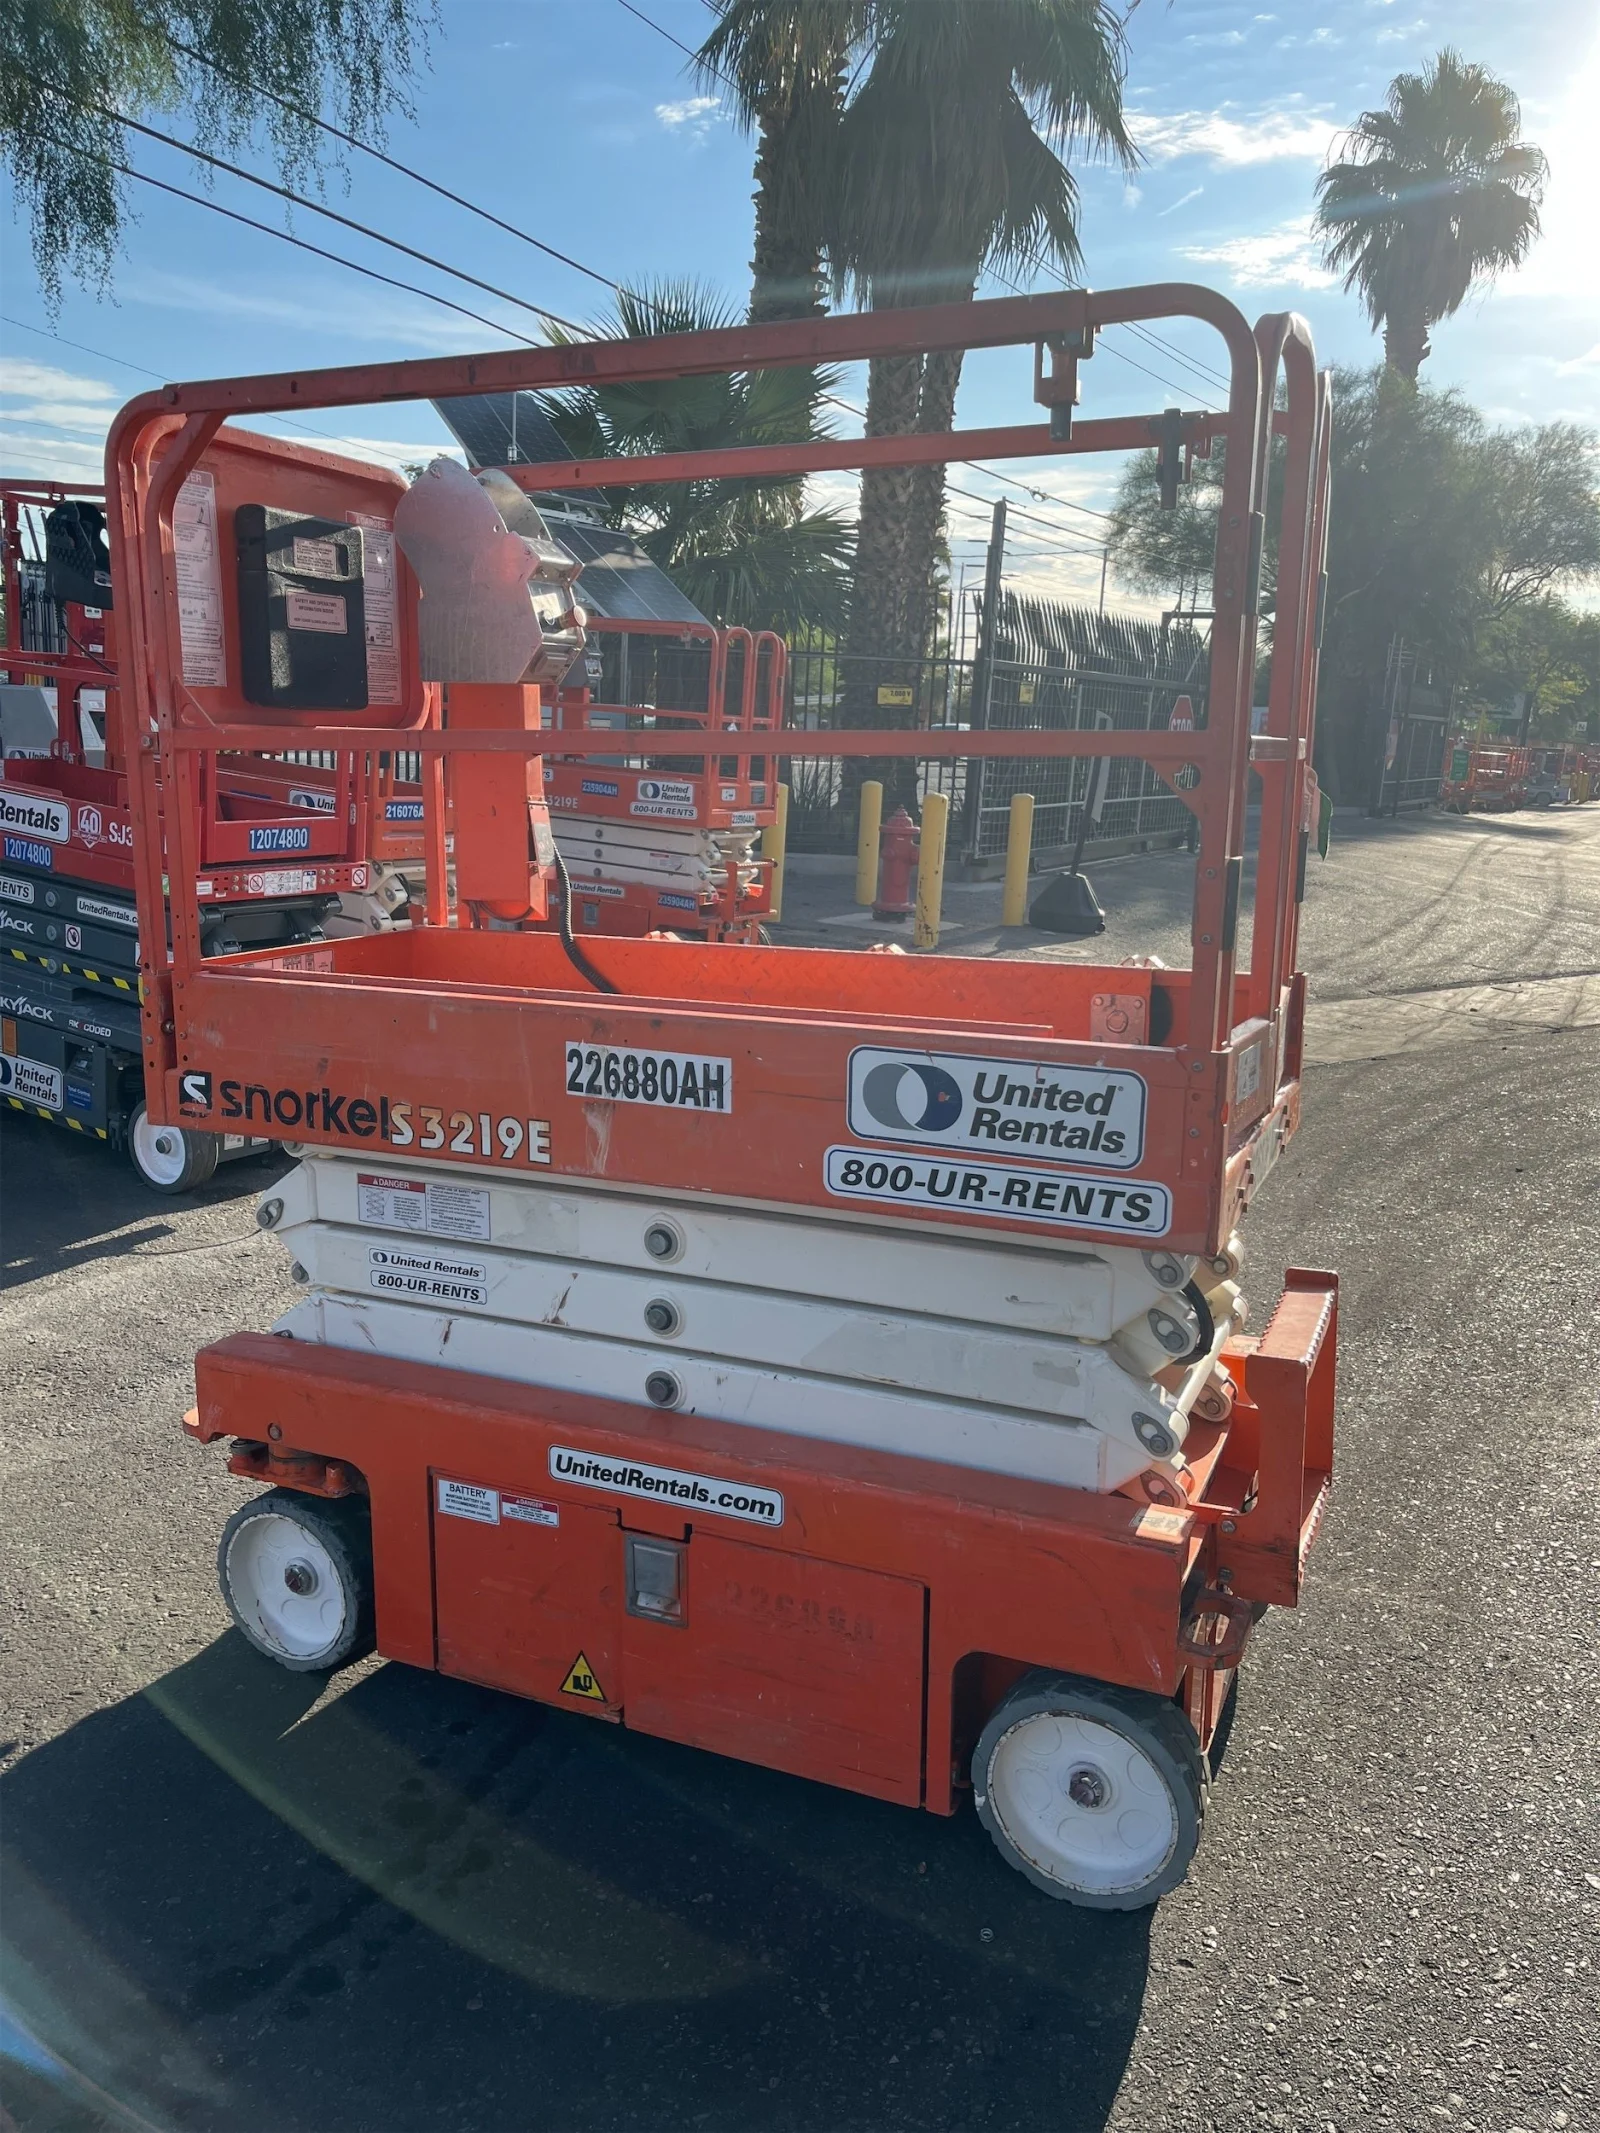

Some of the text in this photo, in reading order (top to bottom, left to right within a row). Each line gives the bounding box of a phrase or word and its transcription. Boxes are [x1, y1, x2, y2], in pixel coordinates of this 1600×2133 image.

[660, 793, 691, 803] Rentals
[661, 784, 689, 794] United
[633, 804, 694, 817] 800-UR-RENTS
[249, 828, 309, 850] 12074800
[4, 837, 51, 867] 12074800
[0, 880, 30, 898] ENTS
[573, 883, 622, 896] United Rentals
[15, 1062, 54, 1087] United
[566, 1048, 724, 1109] 226880AH
[15, 1077, 58, 1103] Rentals
[972, 1072, 1116, 1117] United
[220, 1080, 552, 1165] snorkel S3219E
[968, 1107, 1126, 1154] Rentals
[379, 1178, 410, 1190] DANGER
[840, 1159, 1154, 1223] 800-UR-RENTS
[390, 1254, 480, 1278] United Rentals
[378, 1274, 480, 1301] 800-UR-RENTS
[449, 1483, 487, 1499] BATTERY
[555, 1453, 776, 1517] UnitedRentals.com
[520, 1499, 544, 1508] DANGER
